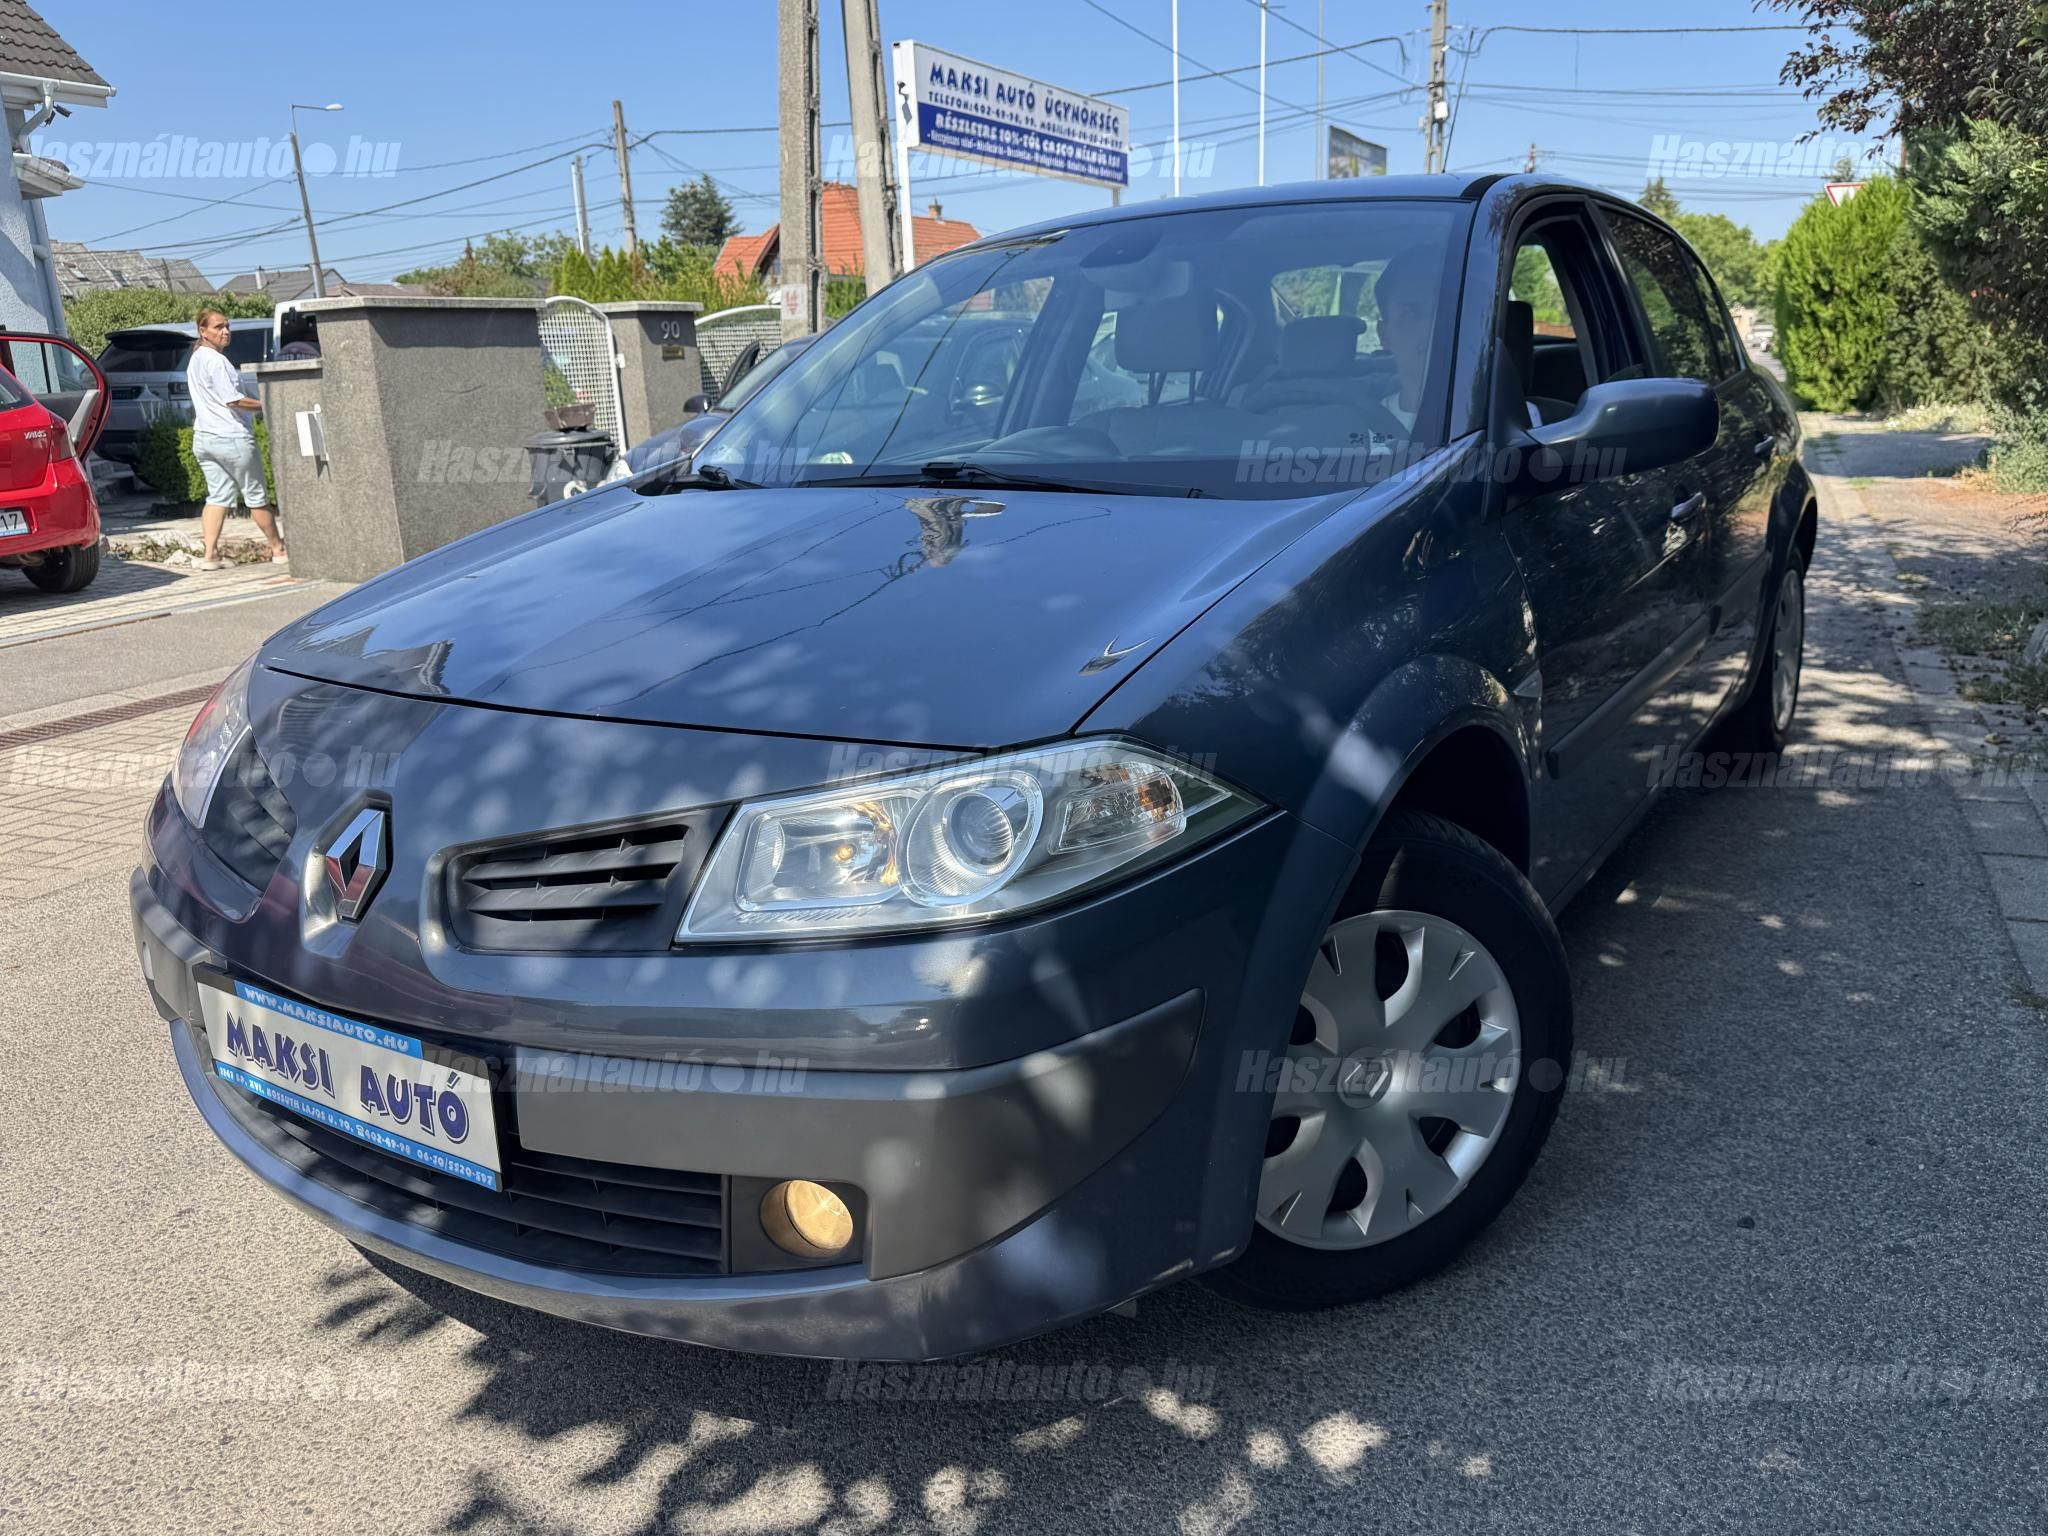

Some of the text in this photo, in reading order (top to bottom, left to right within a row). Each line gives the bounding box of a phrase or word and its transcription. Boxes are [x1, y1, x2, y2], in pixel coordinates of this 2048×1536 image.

[930, 61, 1119, 135] MAKSI AUTÓ ÜGYNÖKSÉG
[935, 111, 997, 140] RÉSZLETRE
[1042, 139, 1074, 158] CASCO
[660, 320, 680, 339] 90
[244, 987, 409, 1051] WWW.MAKSIAUTO.HU
[226, 1009, 470, 1145] MAKSI AUTÓ
[301, 1102, 326, 1120] LAJOS
